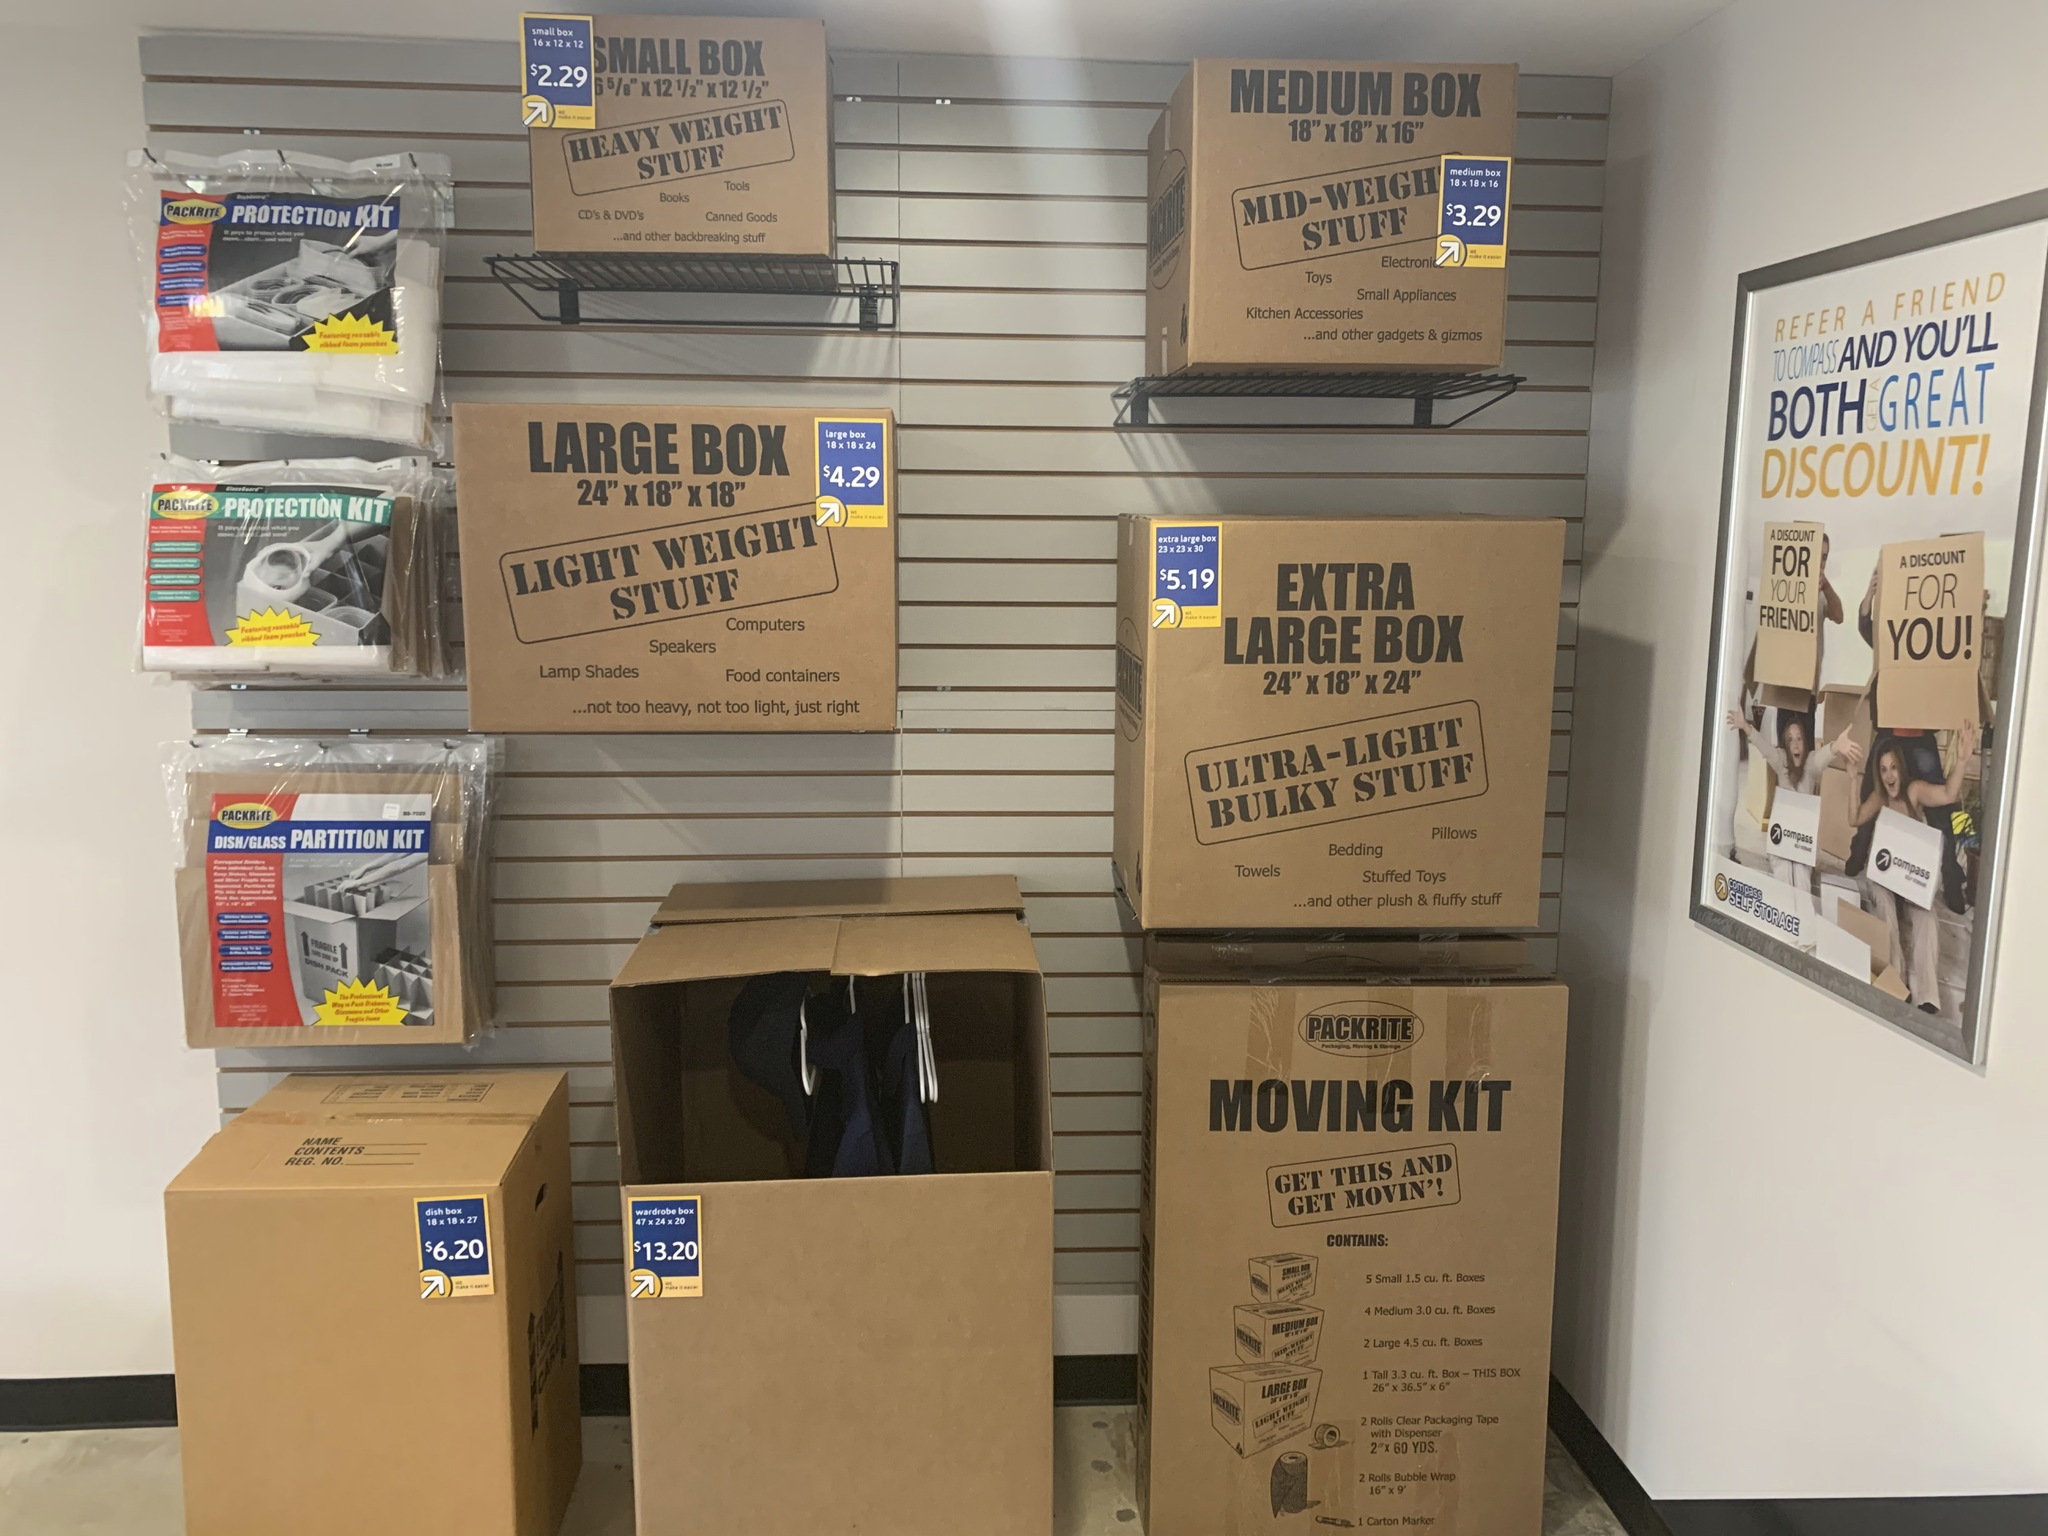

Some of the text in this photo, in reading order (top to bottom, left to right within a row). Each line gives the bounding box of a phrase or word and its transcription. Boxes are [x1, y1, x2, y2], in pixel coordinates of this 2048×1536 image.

[532, 27, 573, 36] small box
[594, 37, 765, 76] SMALL BOX
[530, 63, 588, 88] $2.29
[1231, 69, 1482, 118] MEDIUM BOX
[568, 106, 782, 163] HEAVY WEIGHT
[637, 144, 724, 180] STUFF
[1450, 168, 1501, 177] medium box
[724, 181, 749, 191] Tools
[660, 193, 689, 203] Books
[1240, 166, 1441, 227] MID-WEIGH
[166, 205, 394, 228] PACKRITE PROTECTION KIT
[578, 210, 644, 220] CD's & DVD's
[706, 212, 778, 223] Canned Goods
[1446, 203, 1501, 227] $3.29
[613, 232, 766, 244] ...and other backbreaking stuff
[1301, 206, 1408, 252] STUFF
[1306, 271, 1332, 284] Toys
[1357, 289, 1456, 302] Small Appliances
[1246, 307, 1363, 319] Kitchen Accessories
[1775, 272, 2006, 342] REFER A FRIEND
[1304, 329, 1482, 343] ...and other gadgets & gizmos
[1774, 312, 1999, 382] TO COMPASS AND YOU'LL
[1768, 378, 1867, 442] BOTH
[1867, 401, 1877, 431] GET
[1879, 362, 1995, 432] GREAT
[826, 430, 866, 439] large box
[528, 422, 790, 476] LARGE BOX
[1761, 434, 1991, 498] DISCOUNT!
[823, 465, 880, 489] $4.29
[224, 498, 341, 518] PROTECTION
[348, 498, 388, 522] KIT
[1158, 535, 1217, 545] extra large box
[1771, 530, 1815, 542] A DISCOUNT
[510, 515, 817, 596] LIGHT WEIGHT
[1772, 545, 1811, 578] FOR
[1900, 550, 1966, 569] A DISCOUNT
[1160, 569, 1215, 590] $5.19
[1277, 562, 1415, 611] EXTRA
[610, 569, 739, 621] STUFF
[1771, 579, 1806, 604] YOUR
[1904, 574, 1958, 611] FOR
[726, 618, 805, 633] Computers
[1760, 605, 1814, 633] FRIEND!
[649, 640, 716, 654] Speakers
[1224, 615, 1464, 664] LARGE BOX
[1887, 615, 1973, 661] YOU!
[540, 665, 639, 680] Lamp Shades
[726, 669, 840, 683] Food containers
[573, 701, 860, 717] ...not too heavy, not too light, just right
[1196, 717, 1463, 793] ULTRA-LIGHT
[1207, 753, 1474, 828] BULKY STUFF
[222, 810, 272, 822] PACKRITE
[215, 830, 424, 849] DISH/GLASS PARTITION KIT
[1432, 828, 1477, 839] Pillows
[1783, 829, 1813, 844] compass
[1329, 844, 1383, 858] Bedding
[1235, 865, 1280, 878] Towels
[1363, 870, 1446, 885] Stuffed Toys
[1893, 856, 1931, 880] compass
[1728, 877, 1762, 900] compass
[1294, 892, 1502, 909] ...and other plush & fluffy stuff
[1729, 890, 1800, 936] SELF STORAGE
[1307, 1015, 1415, 1041] PACKRITE
[1209, 1079, 1511, 1132] MOVING KIT
[295, 1146, 365, 1155] CONTENTS
[303, 1137, 342, 1146] NAME
[285, 1157, 344, 1166] REG. NO.
[1275, 1153, 1452, 1195] GET THIS AND
[1288, 1178, 1444, 1216] GET MOVIN'!
[426, 1207, 462, 1216] dish box
[425, 1239, 484, 1261] $6.20
[1327, 1234, 1388, 1247] CONTAINS:
[634, 1241, 697, 1261] $13.20
[1366, 1273, 1485, 1283] 5 Small 1.5 cu. ft. Boxes
[1371, 1428, 1442, 1440] with Dispenser
[1359, 1472, 1456, 1484] 2 Rolls Bubble Wrap
[1358, 1516, 1435, 1526] 1 Carton Marker
